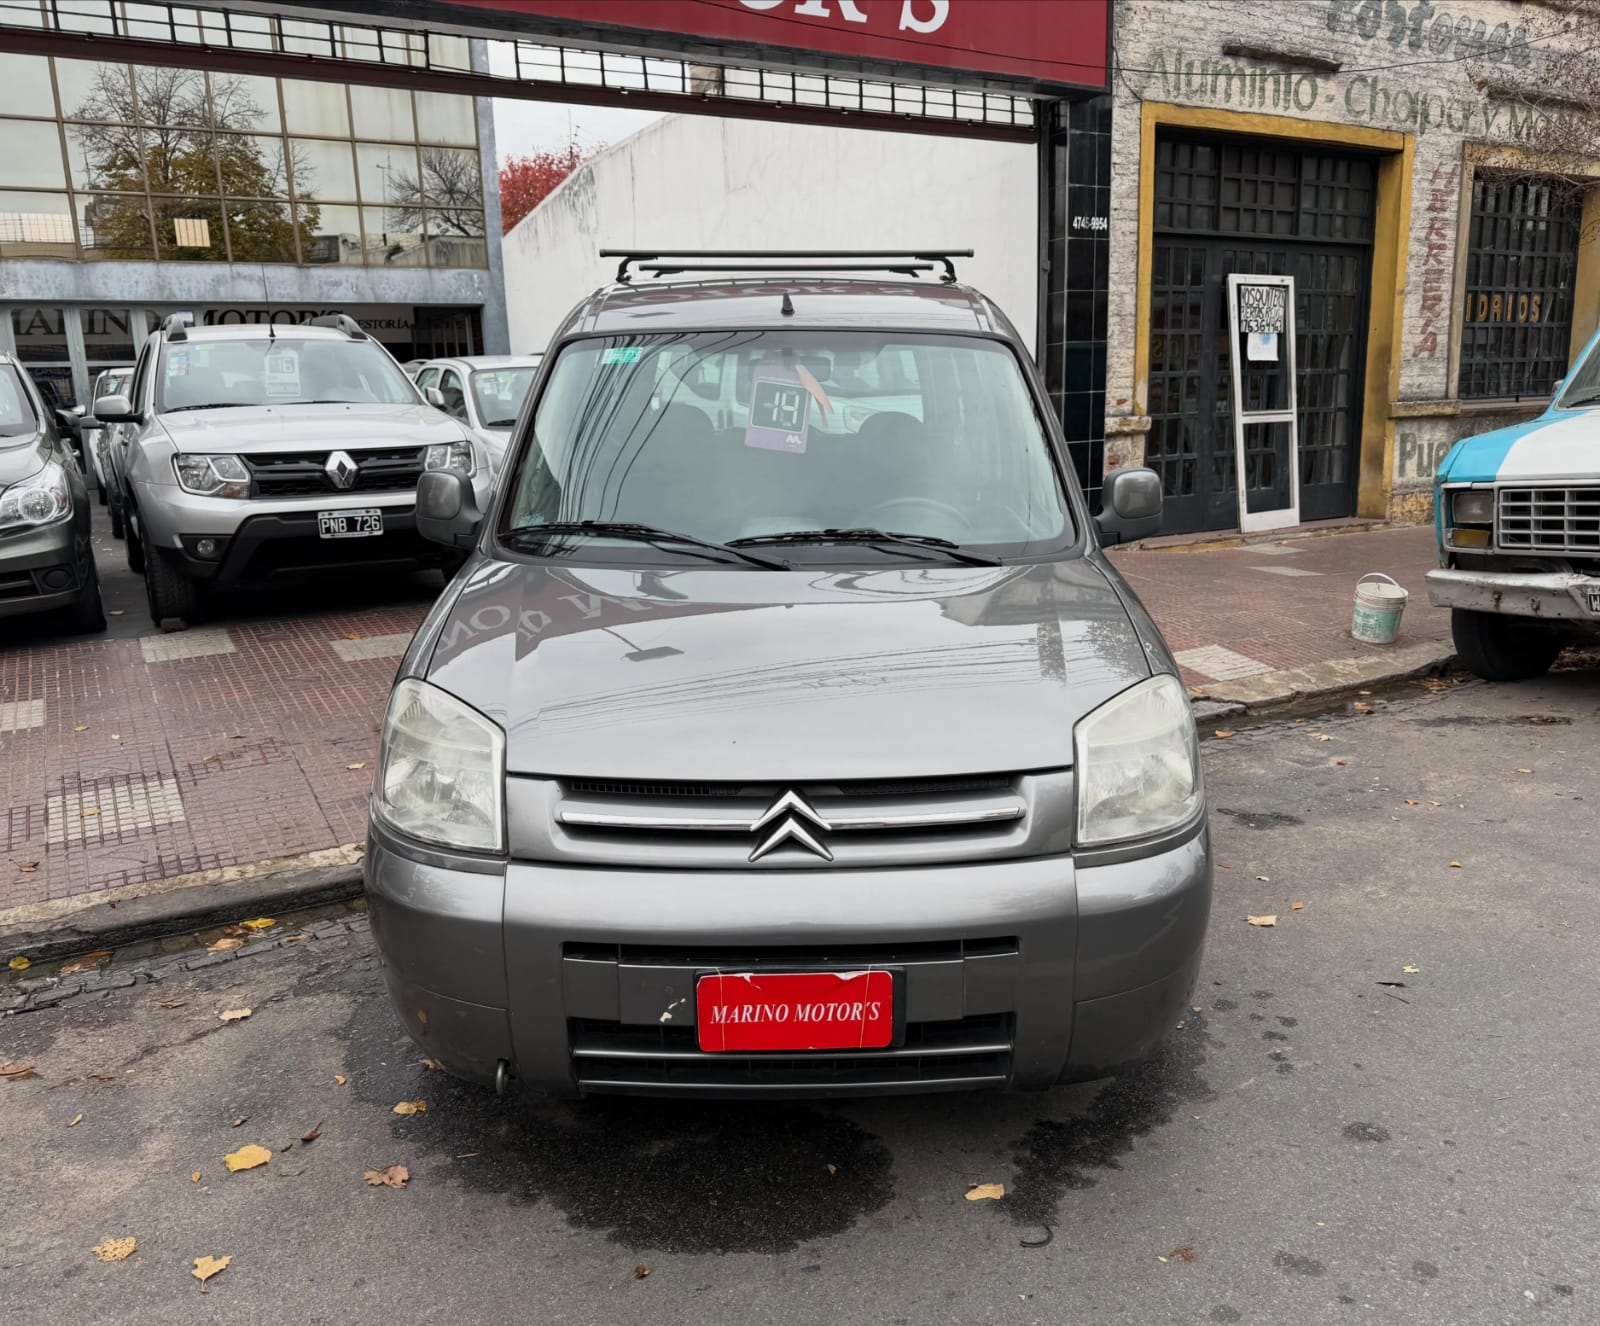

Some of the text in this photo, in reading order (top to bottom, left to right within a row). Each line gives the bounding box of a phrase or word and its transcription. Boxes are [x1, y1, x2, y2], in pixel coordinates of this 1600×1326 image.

[354, 317, 410, 329] ESTORÍA
[321, 516, 380, 533] PNB 726
[710, 1003, 789, 1024] MARINO
